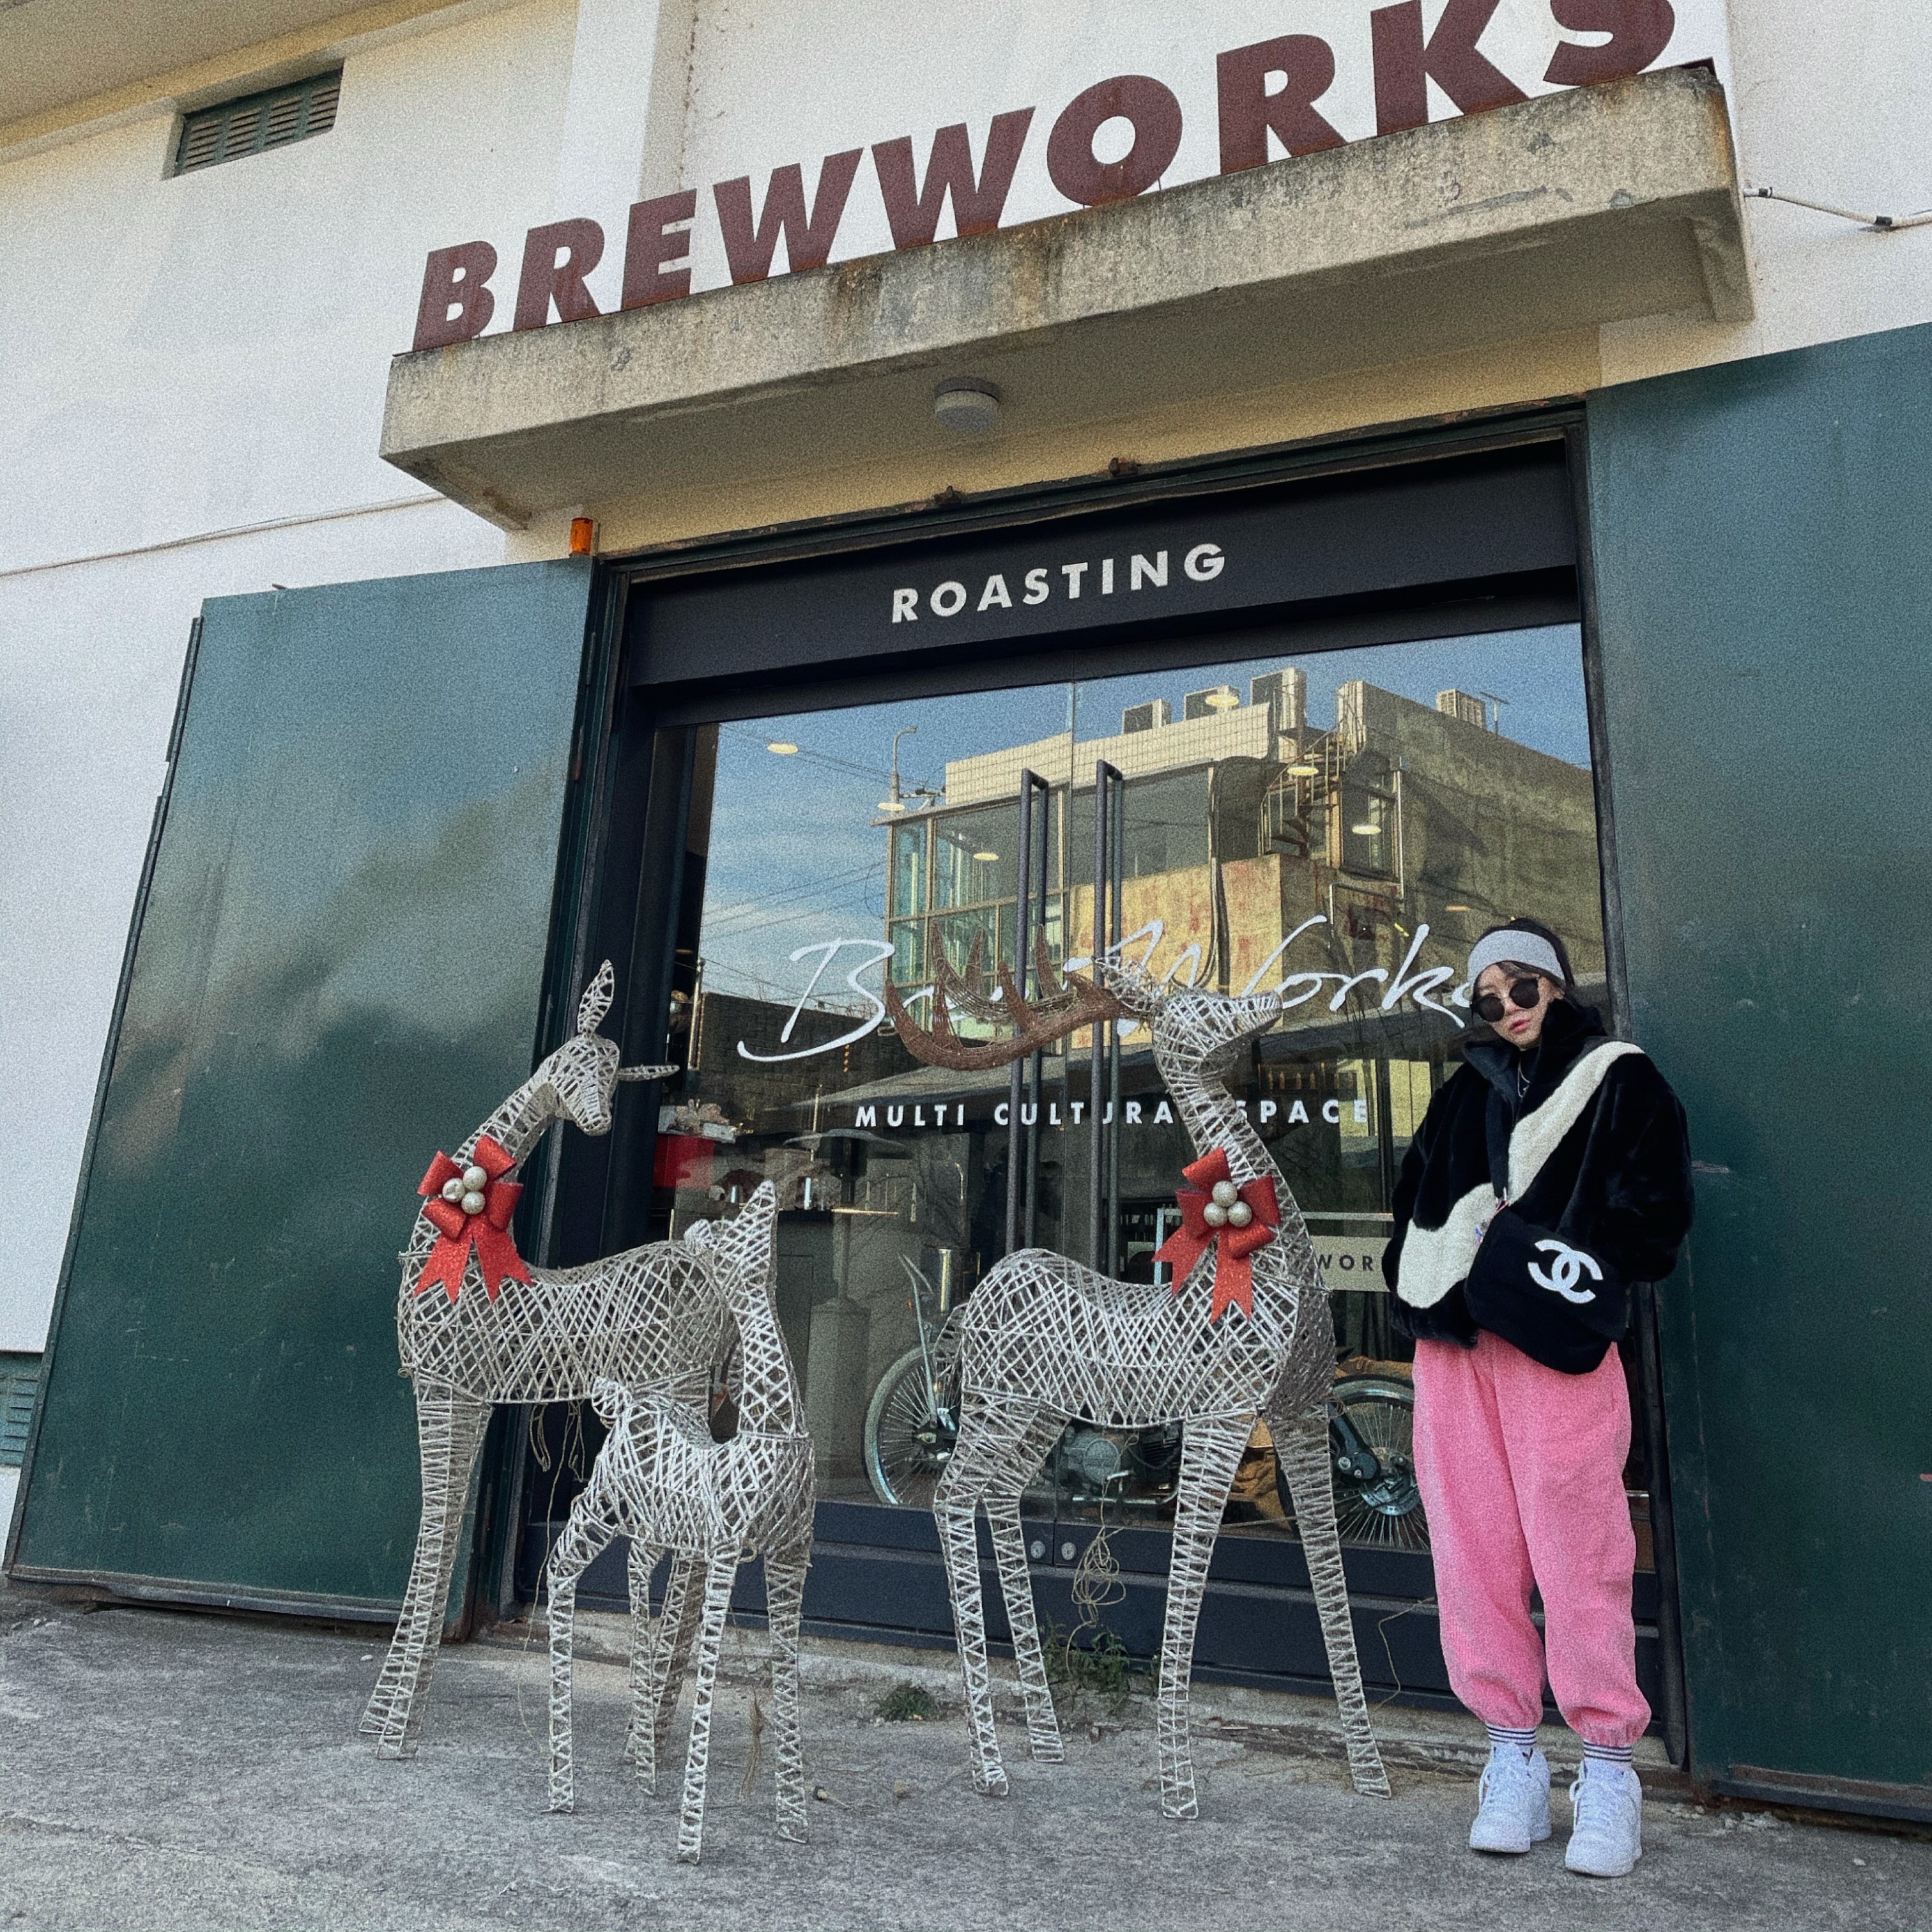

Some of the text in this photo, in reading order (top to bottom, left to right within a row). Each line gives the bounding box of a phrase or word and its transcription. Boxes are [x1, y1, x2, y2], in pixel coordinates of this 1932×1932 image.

[891, 542, 1226, 624] ROASTING
[855, 1103, 965, 1127] MULTI
[993, 1100, 1175, 1126] CULTURA
